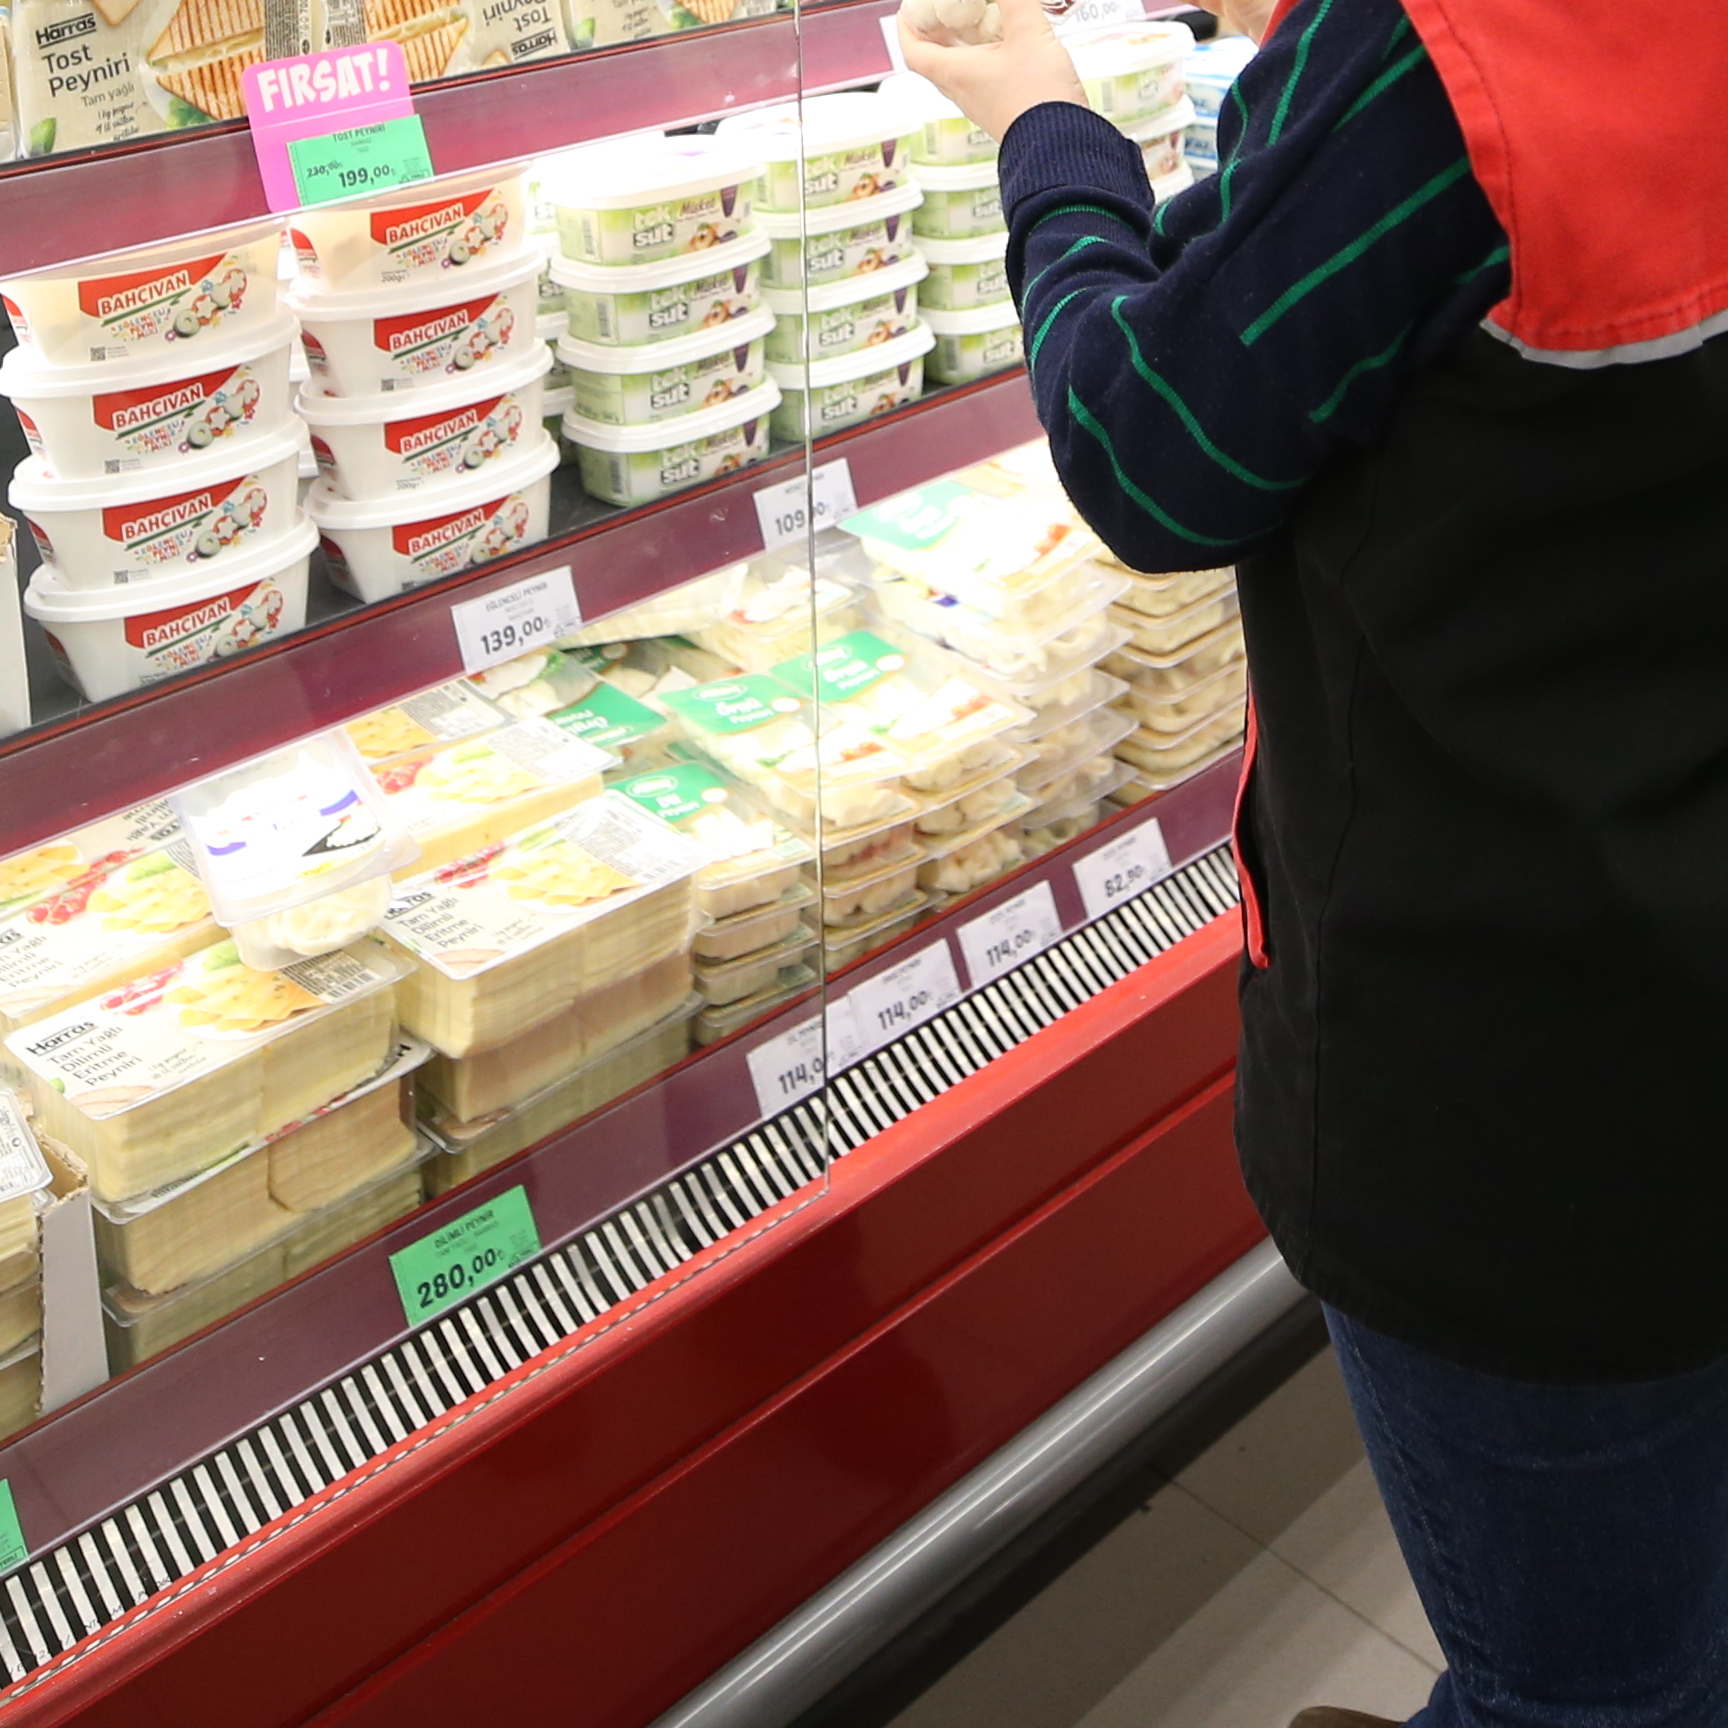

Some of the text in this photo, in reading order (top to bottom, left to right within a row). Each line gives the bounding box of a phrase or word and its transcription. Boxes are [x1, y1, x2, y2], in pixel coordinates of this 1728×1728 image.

[41, 43, 93, 74] Tost
[256, 48, 390, 113] FIRSAT!
[386, 201, 465, 246] BAHÇIVAN
[100, 271, 191, 316] BAHÇIVAN
[390, 310, 470, 352] BAHÇIVAN
[113, 383, 205, 430] BAHÇIVAN
[401, 410, 478, 454] BAHÇIVAN
[123, 493, 213, 542] BAHÇIVAN
[410, 509, 486, 553] BAHÇIVAN
[142, 597, 234, 647] BAHÇIVAN
